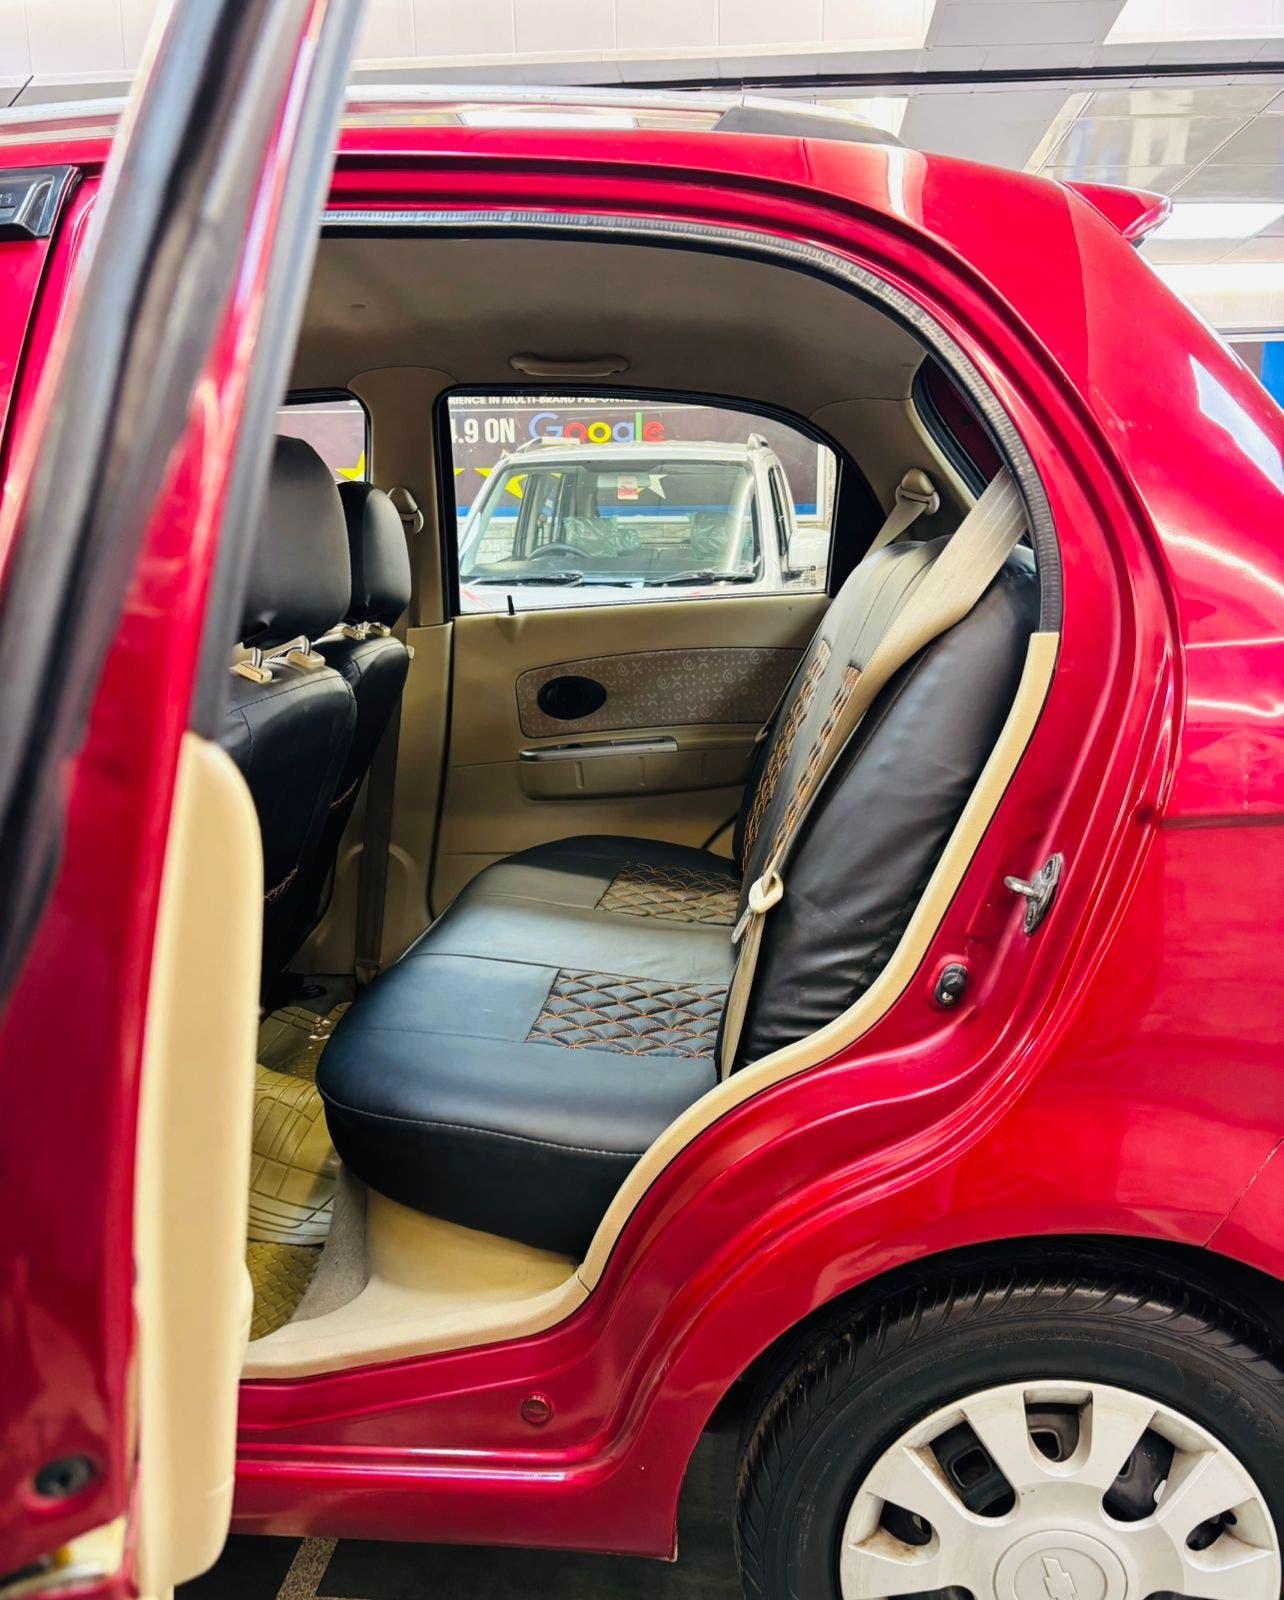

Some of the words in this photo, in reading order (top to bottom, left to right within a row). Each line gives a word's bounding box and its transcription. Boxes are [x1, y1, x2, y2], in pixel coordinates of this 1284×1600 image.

[489, 396, 500, 405] IN
[484, 418, 516, 443] ON
[528, 411, 664, 444] Google
